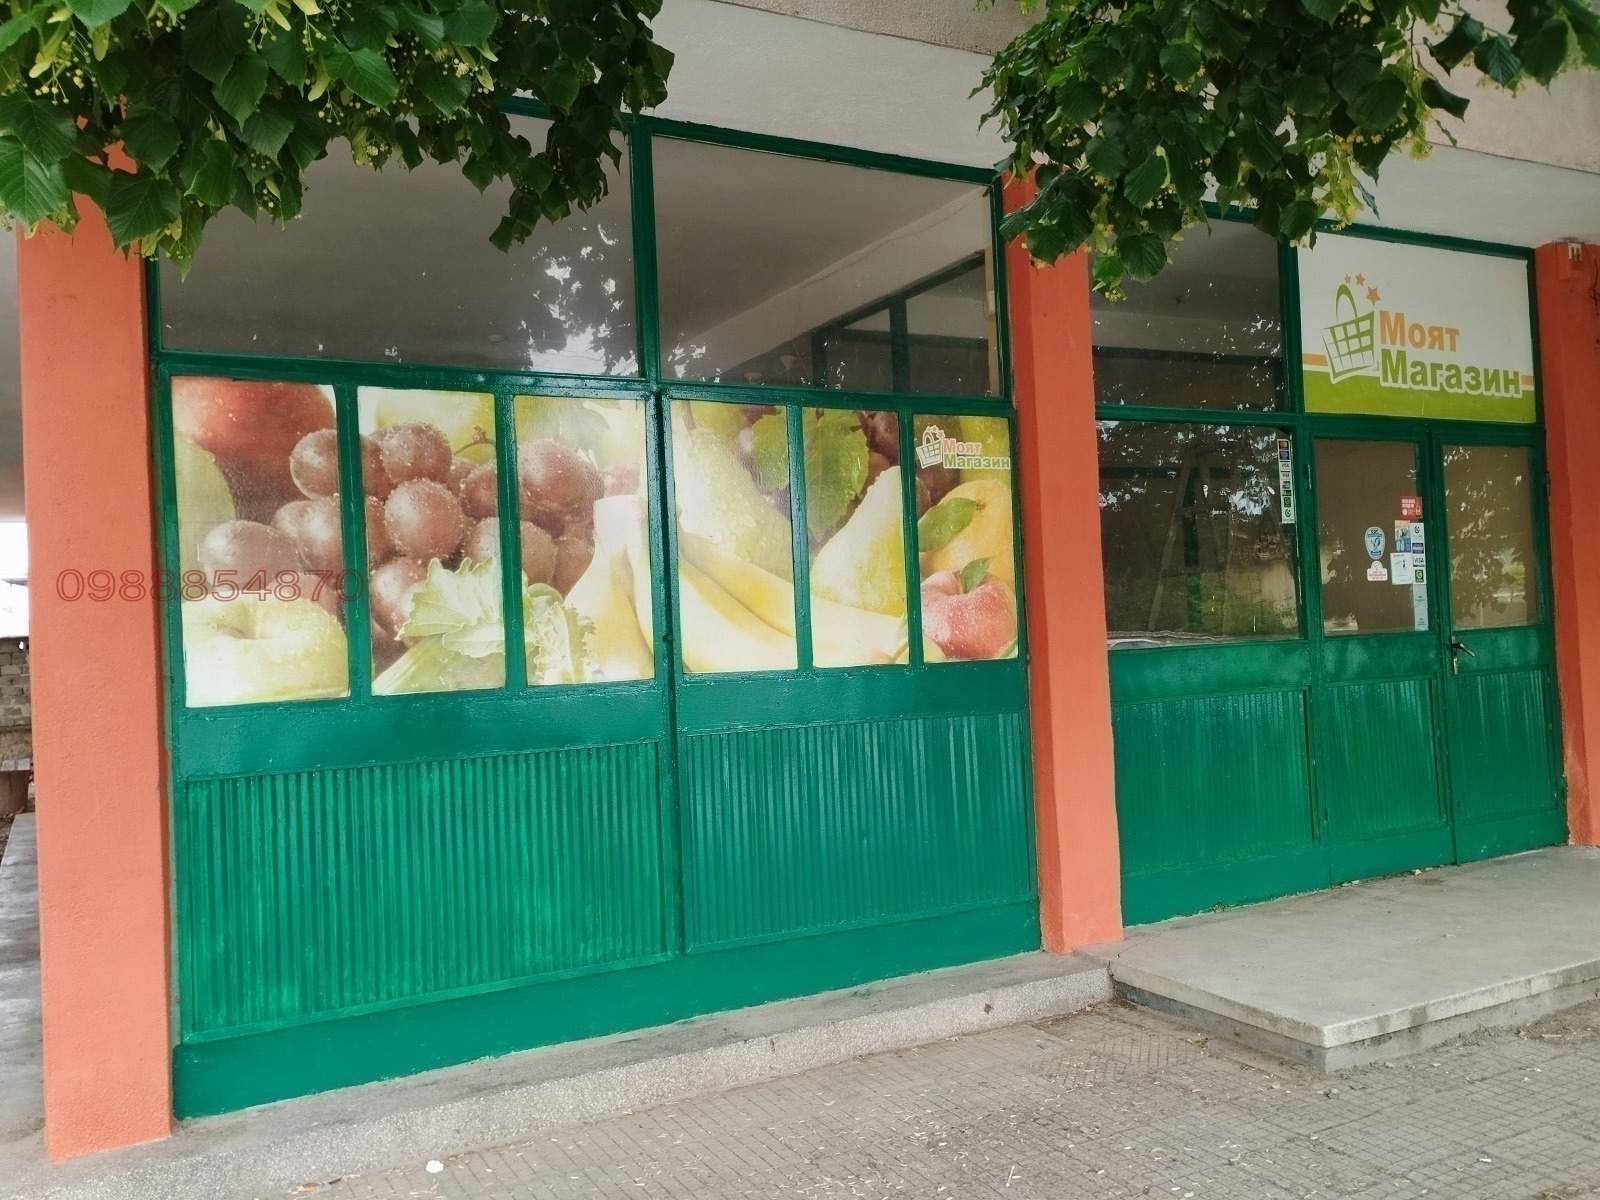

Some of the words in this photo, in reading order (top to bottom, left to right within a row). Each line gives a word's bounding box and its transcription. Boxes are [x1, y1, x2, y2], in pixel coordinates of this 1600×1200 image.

[1379, 309, 1460, 352] Моят
[1380, 348, 1521, 394] Магазин
[943, 438, 982, 455] Моят
[943, 454, 1010, 469] Магазин
